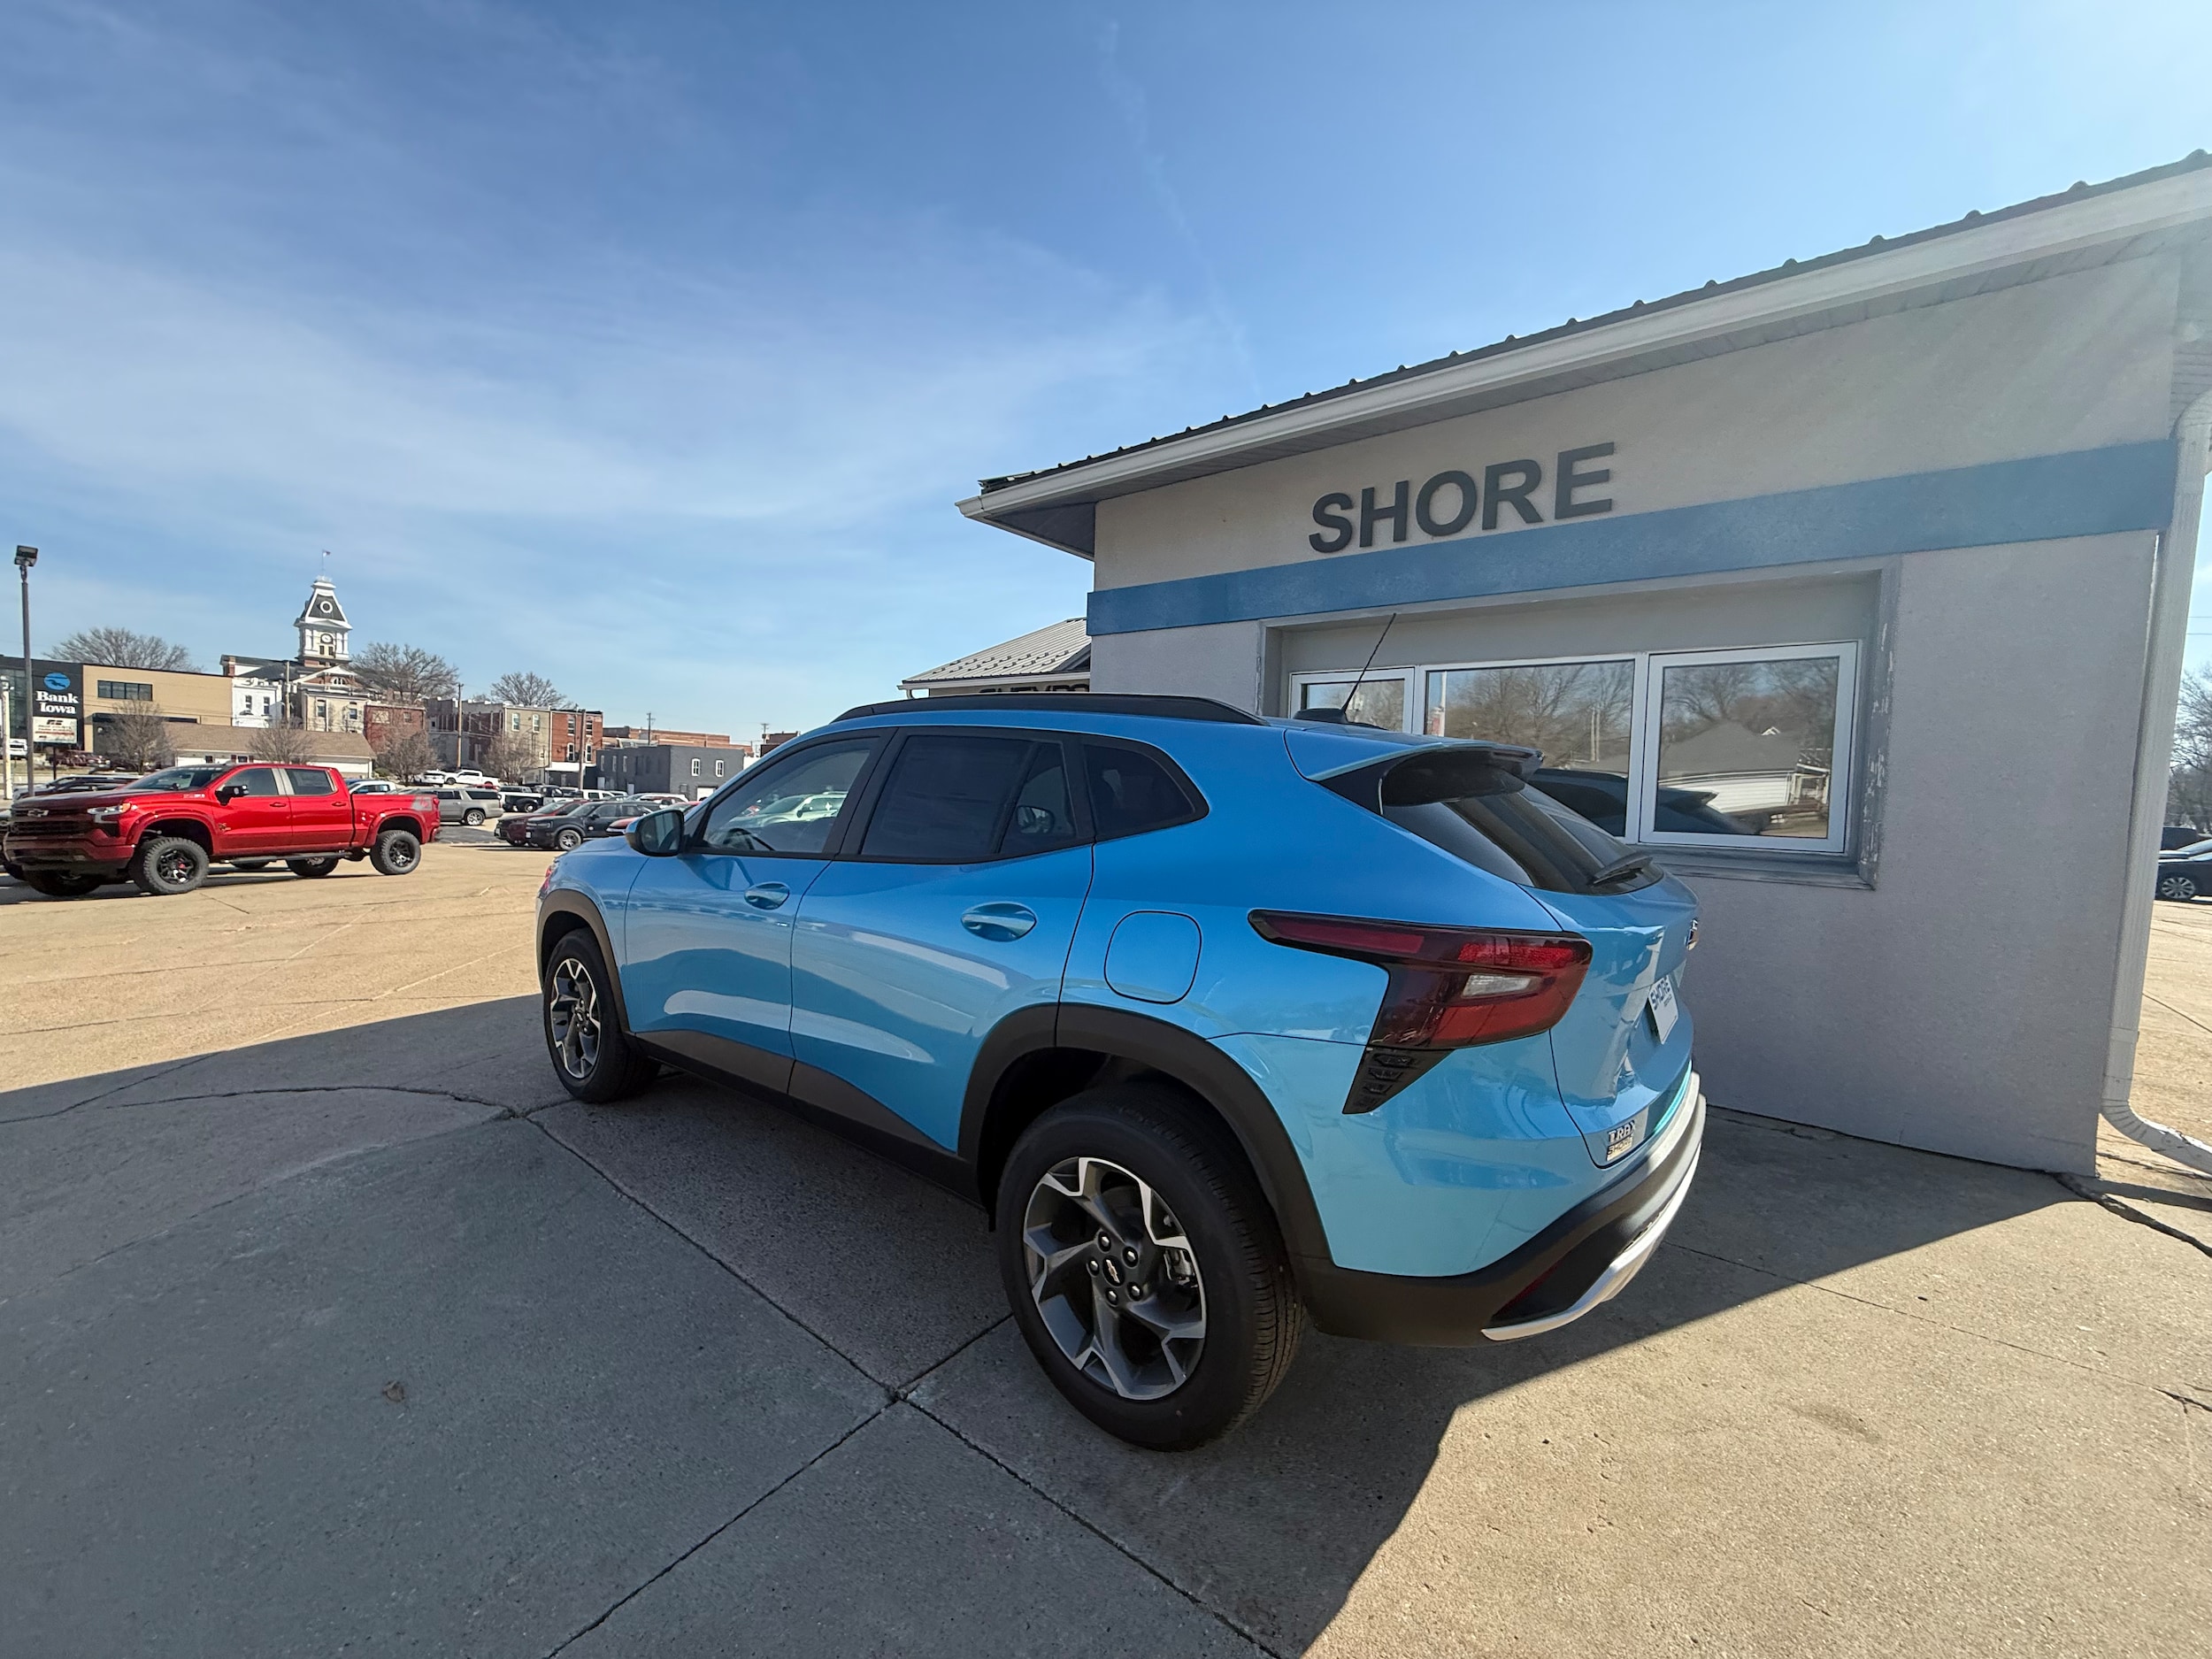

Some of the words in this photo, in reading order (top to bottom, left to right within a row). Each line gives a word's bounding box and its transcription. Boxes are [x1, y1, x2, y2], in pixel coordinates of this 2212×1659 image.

[1309, 442, 1615, 553] SHORE
[35, 691, 79, 703] Bank
[40, 702, 76, 714] Iowa
[1650, 975, 1671, 1010] SHORE
[1608, 1120, 1635, 1143] TRAX
